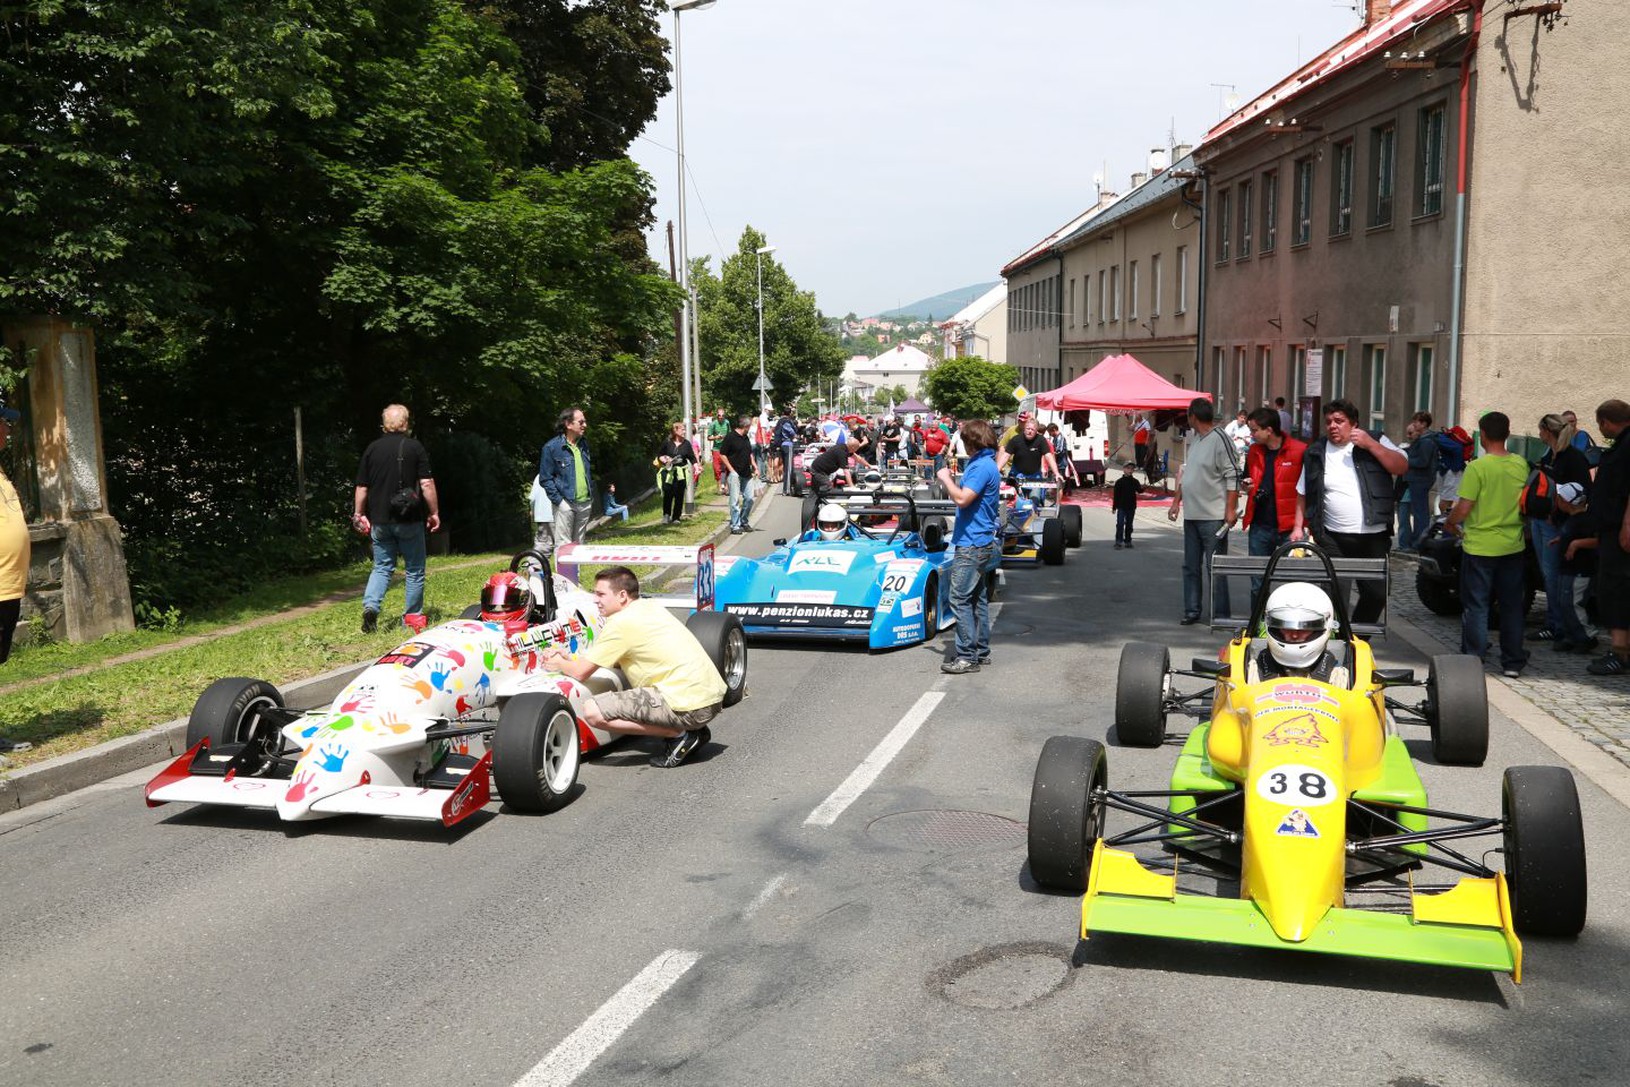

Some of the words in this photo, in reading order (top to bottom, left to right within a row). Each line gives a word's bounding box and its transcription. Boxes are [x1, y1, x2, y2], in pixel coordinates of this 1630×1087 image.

[882, 575, 907, 592] 20
[727, 606, 869, 618] www.penzionlukas.cz
[1269, 772, 1327, 799] 38
